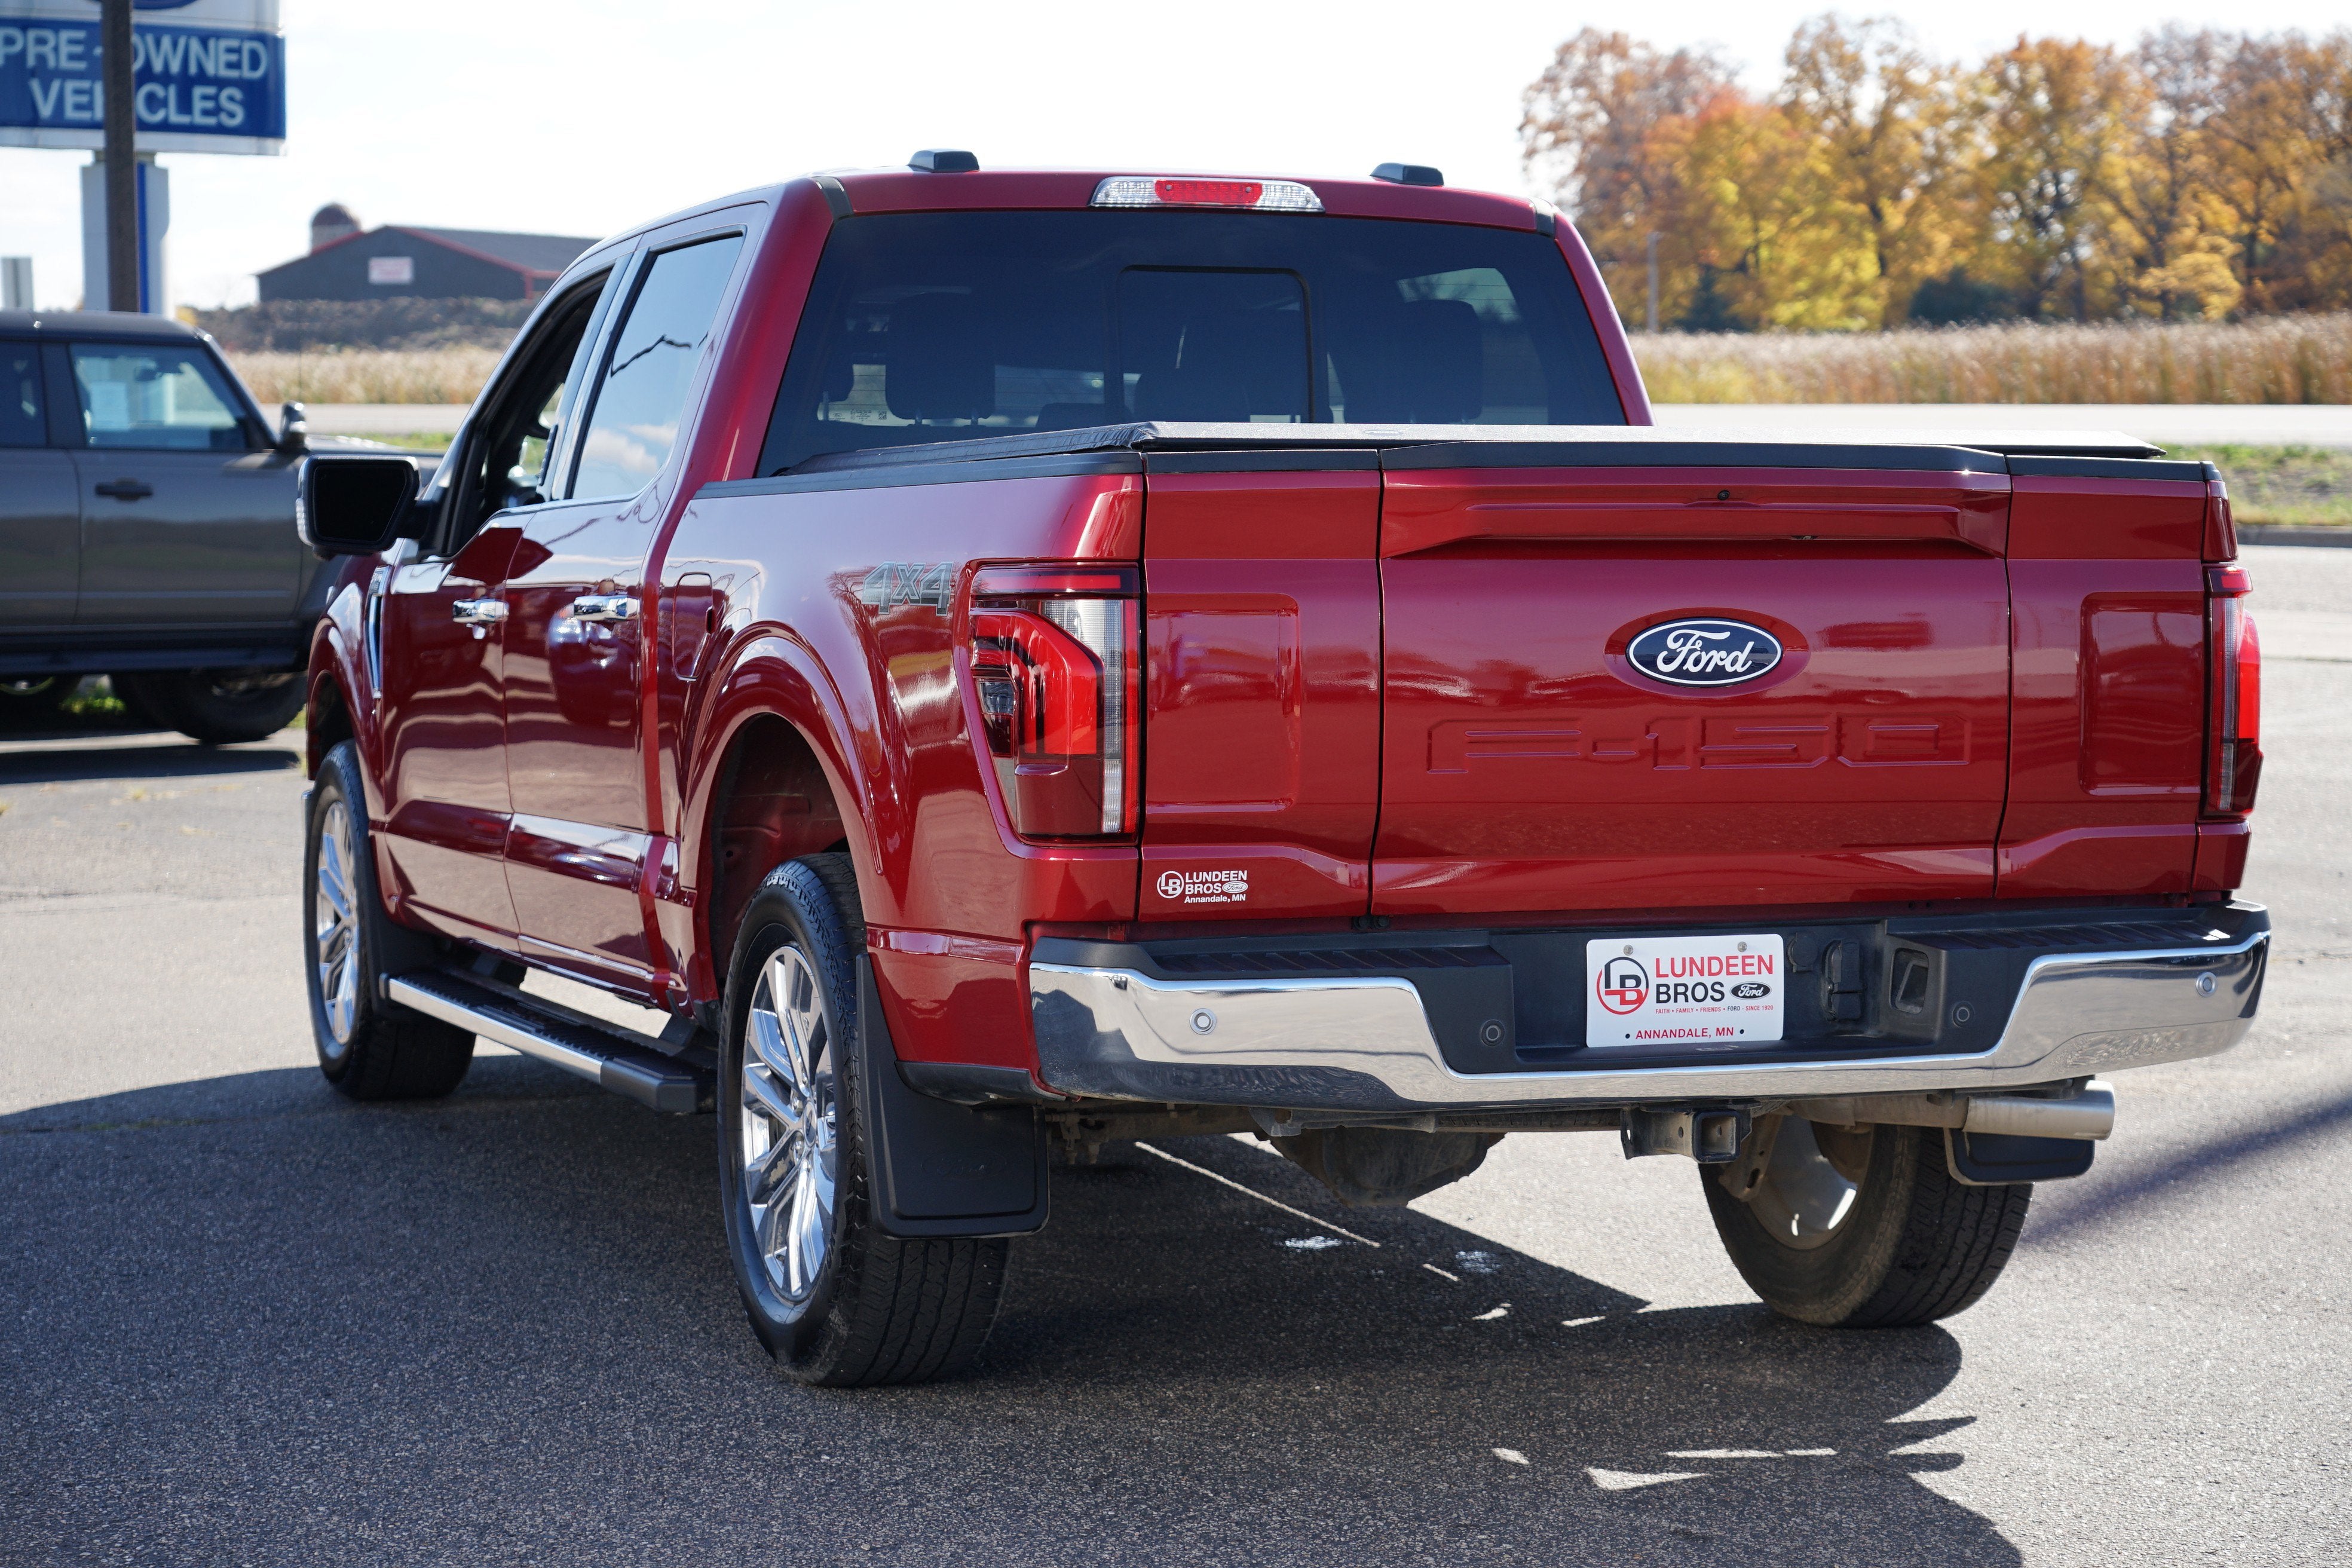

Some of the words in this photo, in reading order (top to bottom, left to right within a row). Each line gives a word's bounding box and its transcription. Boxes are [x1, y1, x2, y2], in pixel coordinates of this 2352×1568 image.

[28, 78, 245, 127] VECLES
[1656, 629, 1755, 673] Ford
[1426, 712, 1971, 774] F-150
[1185, 870, 1248, 883] LUNDEEN
[1184, 895, 1230, 904] Annandale,
[1185, 883, 1222, 895] BROS
[1655, 954, 1774, 978] LUNDEEN
[1655, 981, 1725, 1004] BROS
[1738, 984, 1764, 997] Ford
[1636, 1027, 1712, 1039] ANNANDALE,
[1716, 1027, 1734, 1037] MN
